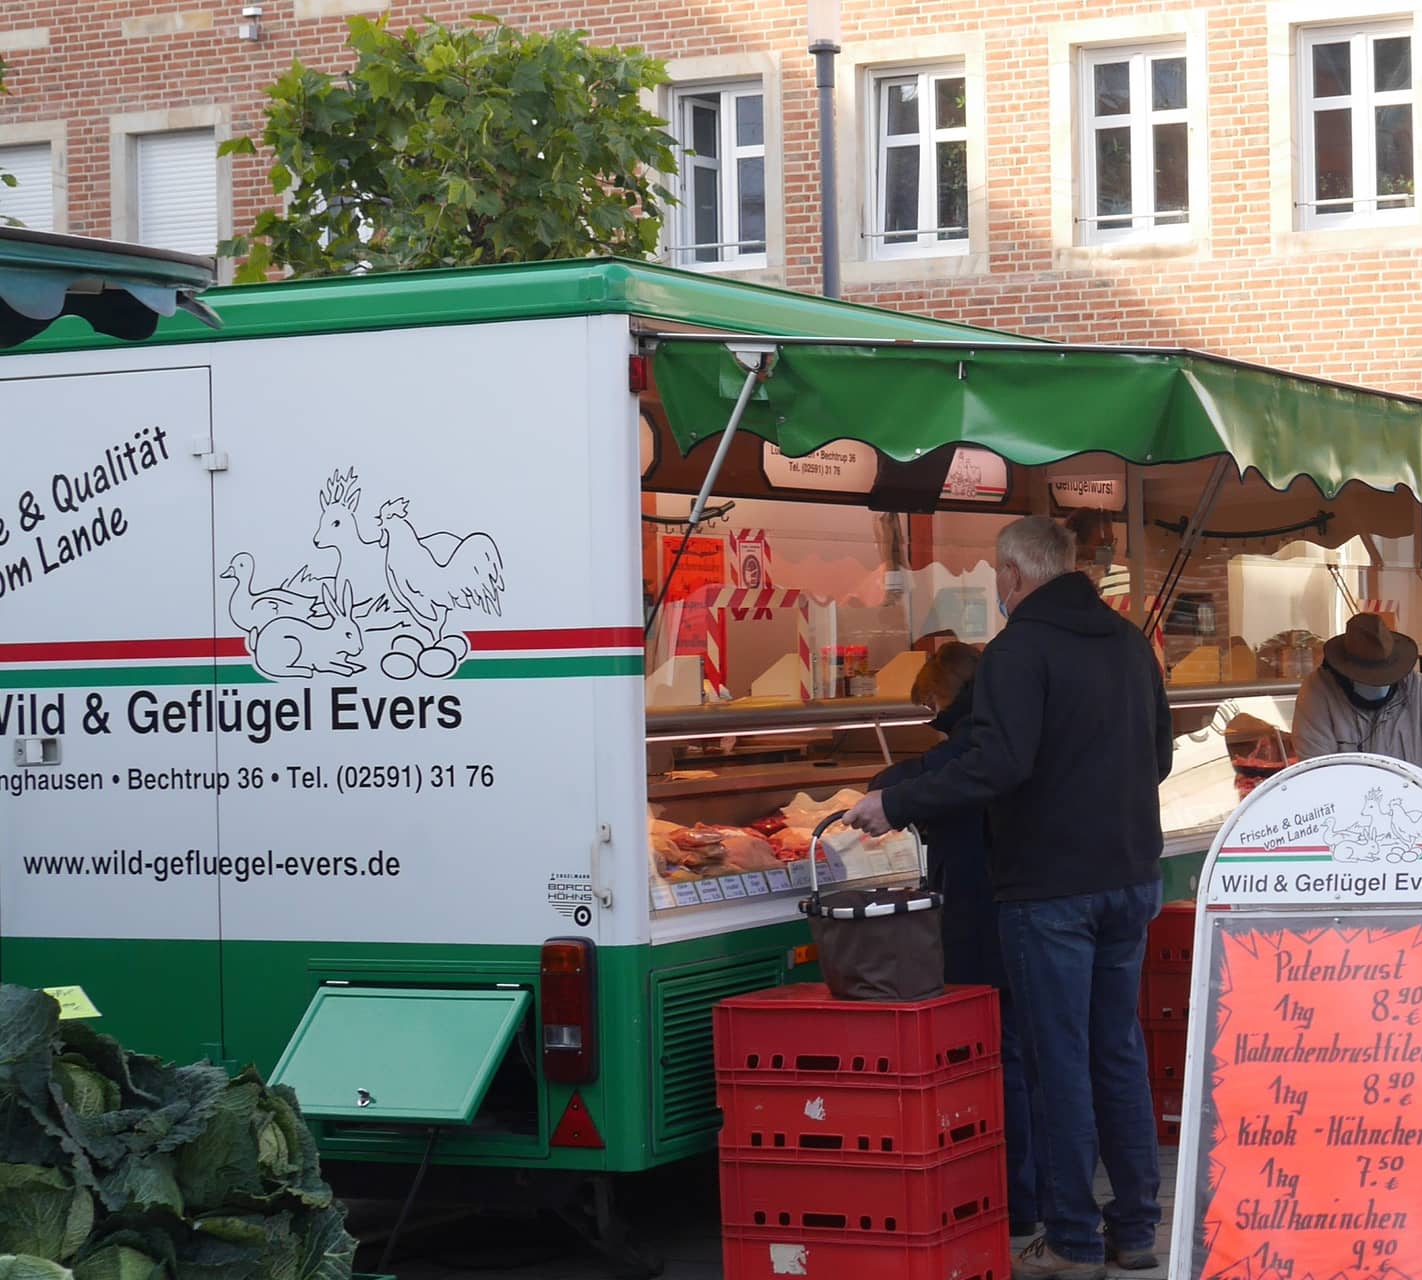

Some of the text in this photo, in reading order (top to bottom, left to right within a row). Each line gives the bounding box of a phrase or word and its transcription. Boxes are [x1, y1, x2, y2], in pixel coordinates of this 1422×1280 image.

[19, 490, 46, 532] &
[52, 426, 169, 513] Qualität
[36, 506, 128, 574] Lande
[83, 692, 112, 735] &
[128, 689, 311, 744] Geflügel
[331, 686, 463, 731] Evers
[128, 768, 230, 795] Bechtrup
[238, 767, 264, 789] 36
[287, 766, 328, 788] Tel.
[337, 764, 422, 794] (02591)
[430, 764, 455, 787] 31
[465, 765, 494, 787] 76
[1240, 803, 1336, 845] Frische & Qualität
[1264, 824, 1320, 849] vom Lande
[23, 850, 400, 882] www.wild-gefluegel-evers.de
[547, 883, 593, 892] BORCO
[1222, 874, 1268, 893] Wild
[1274, 874, 1288, 893] &
[1295, 872, 1386, 896] Geflügel
[1274, 949, 1408, 983] Putenbrust
[1237, 1114, 1297, 1147] Kikok
[1235, 1198, 1407, 1231] Stallkaninchen
